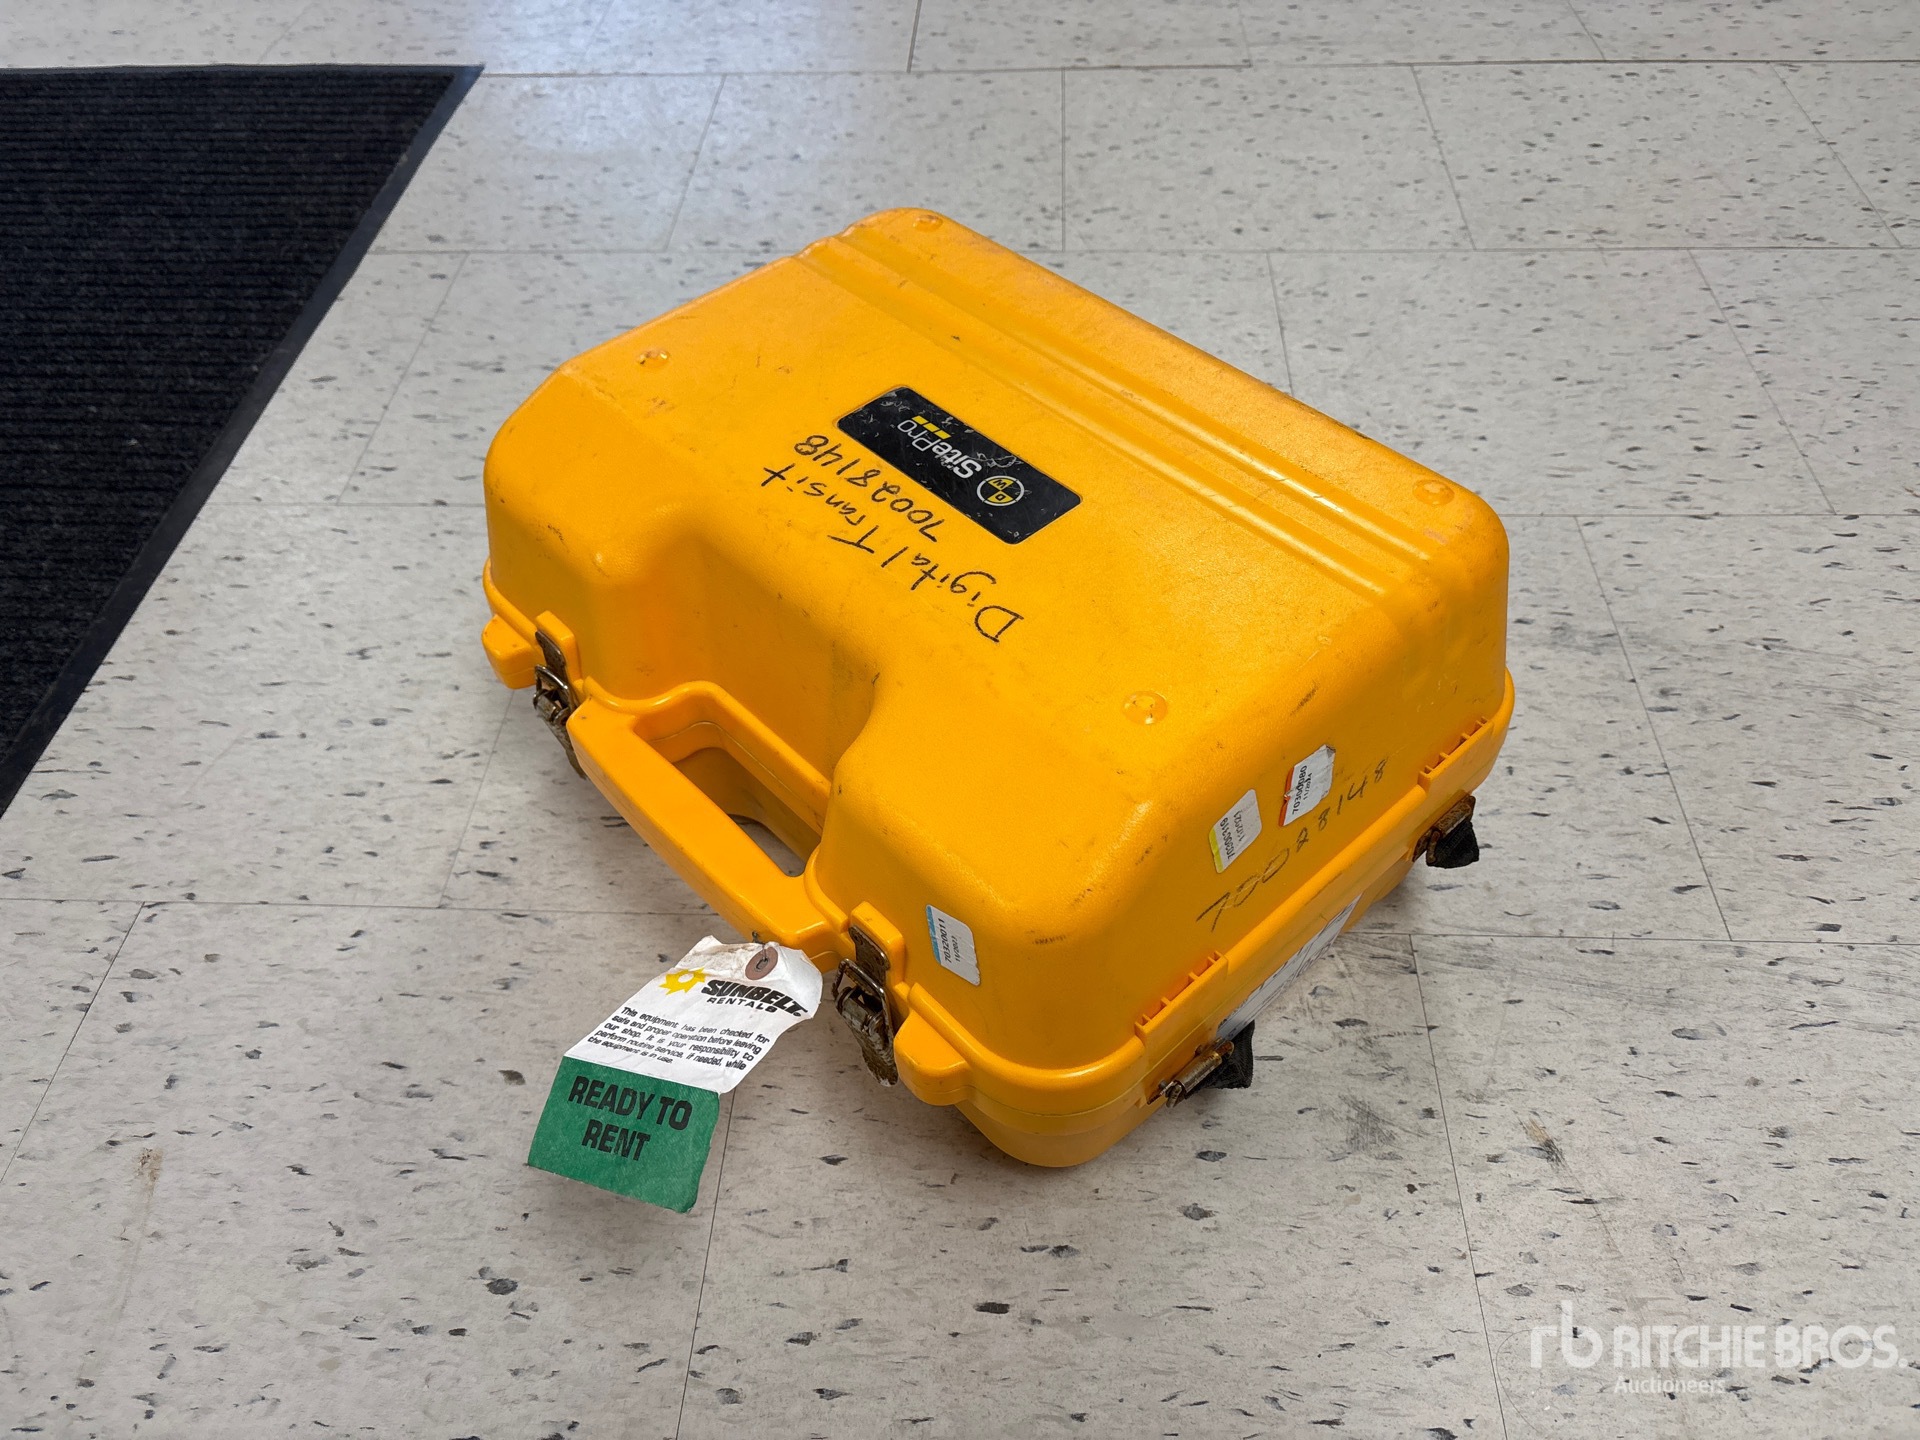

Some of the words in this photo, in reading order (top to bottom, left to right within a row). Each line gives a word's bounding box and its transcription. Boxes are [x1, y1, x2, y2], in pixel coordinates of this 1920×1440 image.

[897, 418, 982, 479] SitePro
[794, 434, 945, 543] 70028148
[995, 492, 1005, 502] D
[762, 464, 880, 555] Transit
[880, 545, 1025, 643] Digital
[621, 1007, 638, 1017] This
[639, 1013, 679, 1028] equipment
[681, 1024, 697, 1032] has
[698, 1026, 718, 1034] been
[719, 1028, 754, 1039] checked
[754, 1033, 770, 1044] for
[707, 997, 778, 1013] RENTALS
[587, 1036, 602, 1044] the
[601, 1041, 641, 1054] equipment
[594, 1030, 627, 1042] perform
[626, 1039, 655, 1050] routine
[725, 1059, 747, 1071] while
[604, 1023, 620, 1031] our
[667, 1040, 687, 1048] your
[688, 1043, 741, 1059] responsibility
[742, 1051, 755, 1062] to
[612, 1015, 630, 1025] safe
[630, 1021, 648, 1030] and
[644, 1025, 672, 1035] proper
[671, 1031, 708, 1042] operation
[707, 1035, 733, 1046] before
[732, 1039, 763, 1056] leaving
[568, 1075, 655, 1120] READY
[656, 1096, 692, 1130] TO
[581, 1119, 651, 1161] RENT
